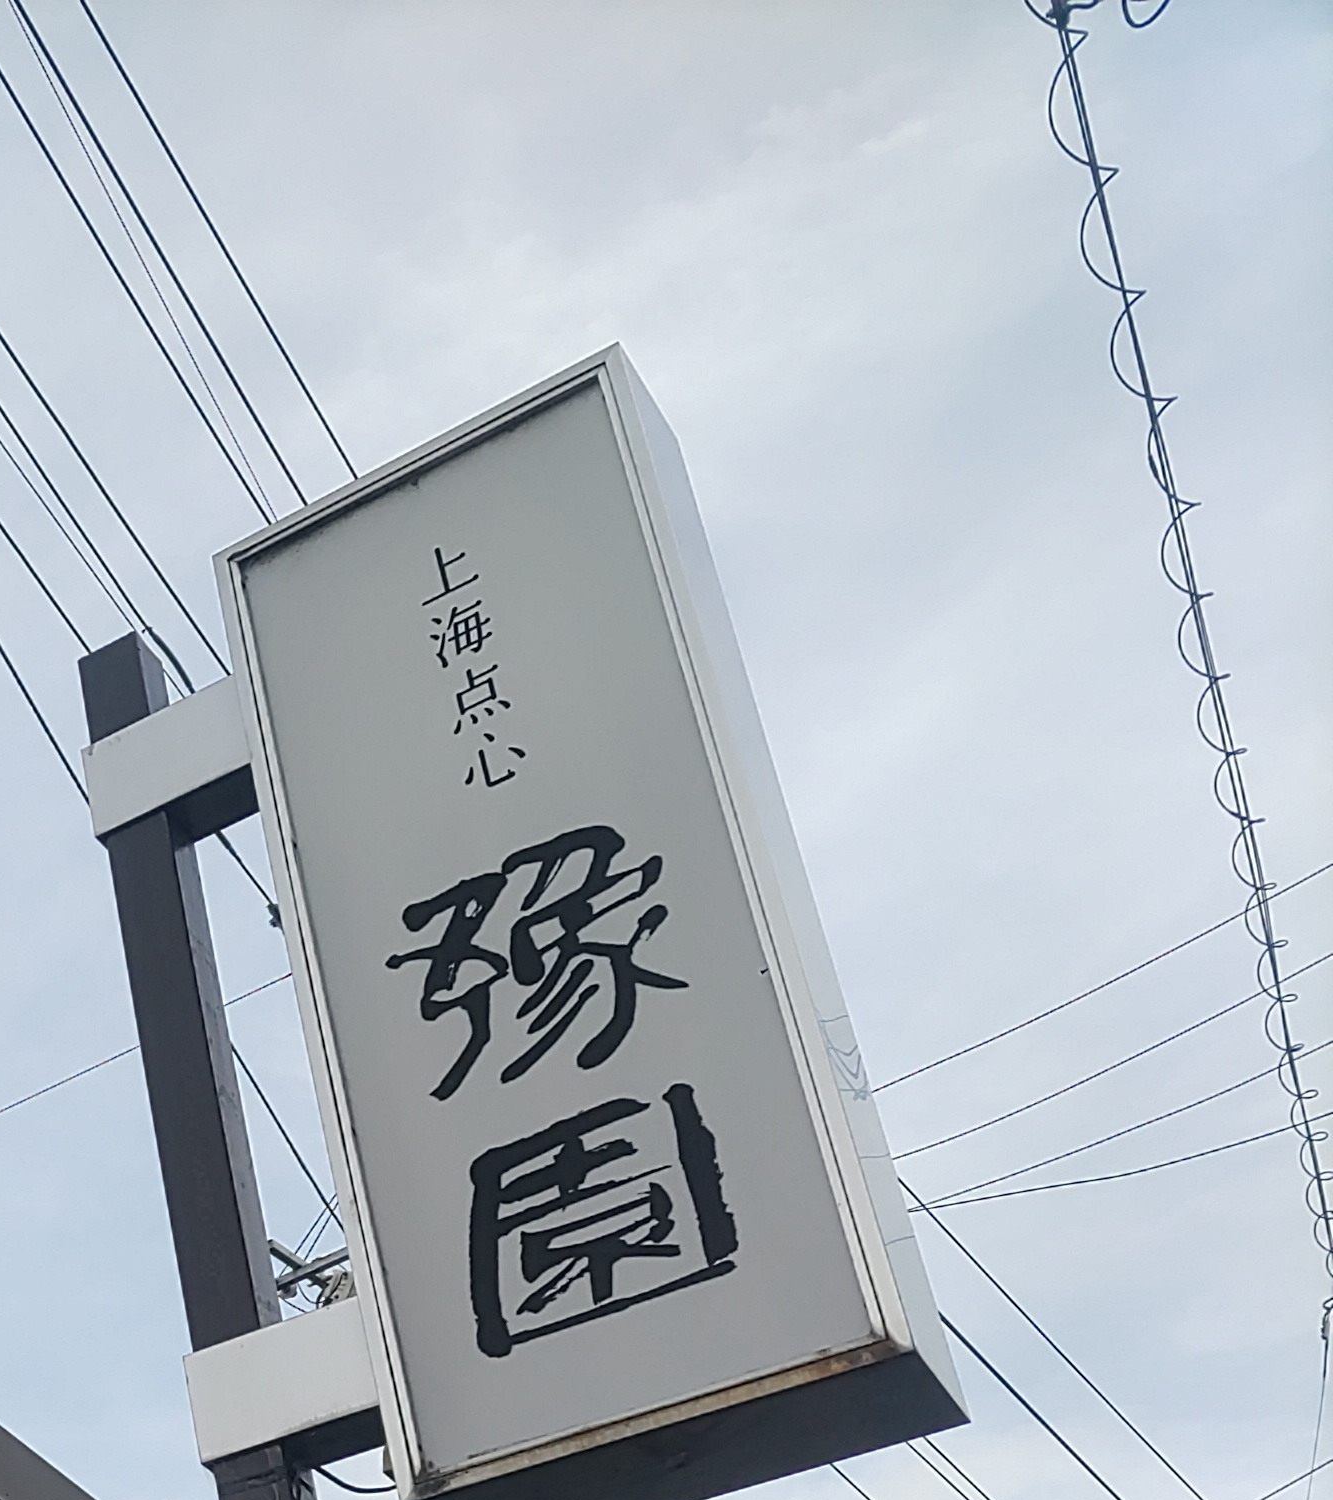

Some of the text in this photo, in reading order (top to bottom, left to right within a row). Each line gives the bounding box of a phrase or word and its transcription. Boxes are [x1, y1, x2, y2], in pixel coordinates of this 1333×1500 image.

[420, 546, 526, 788] 上海点心
[383, 823, 740, 1359] 豫園
